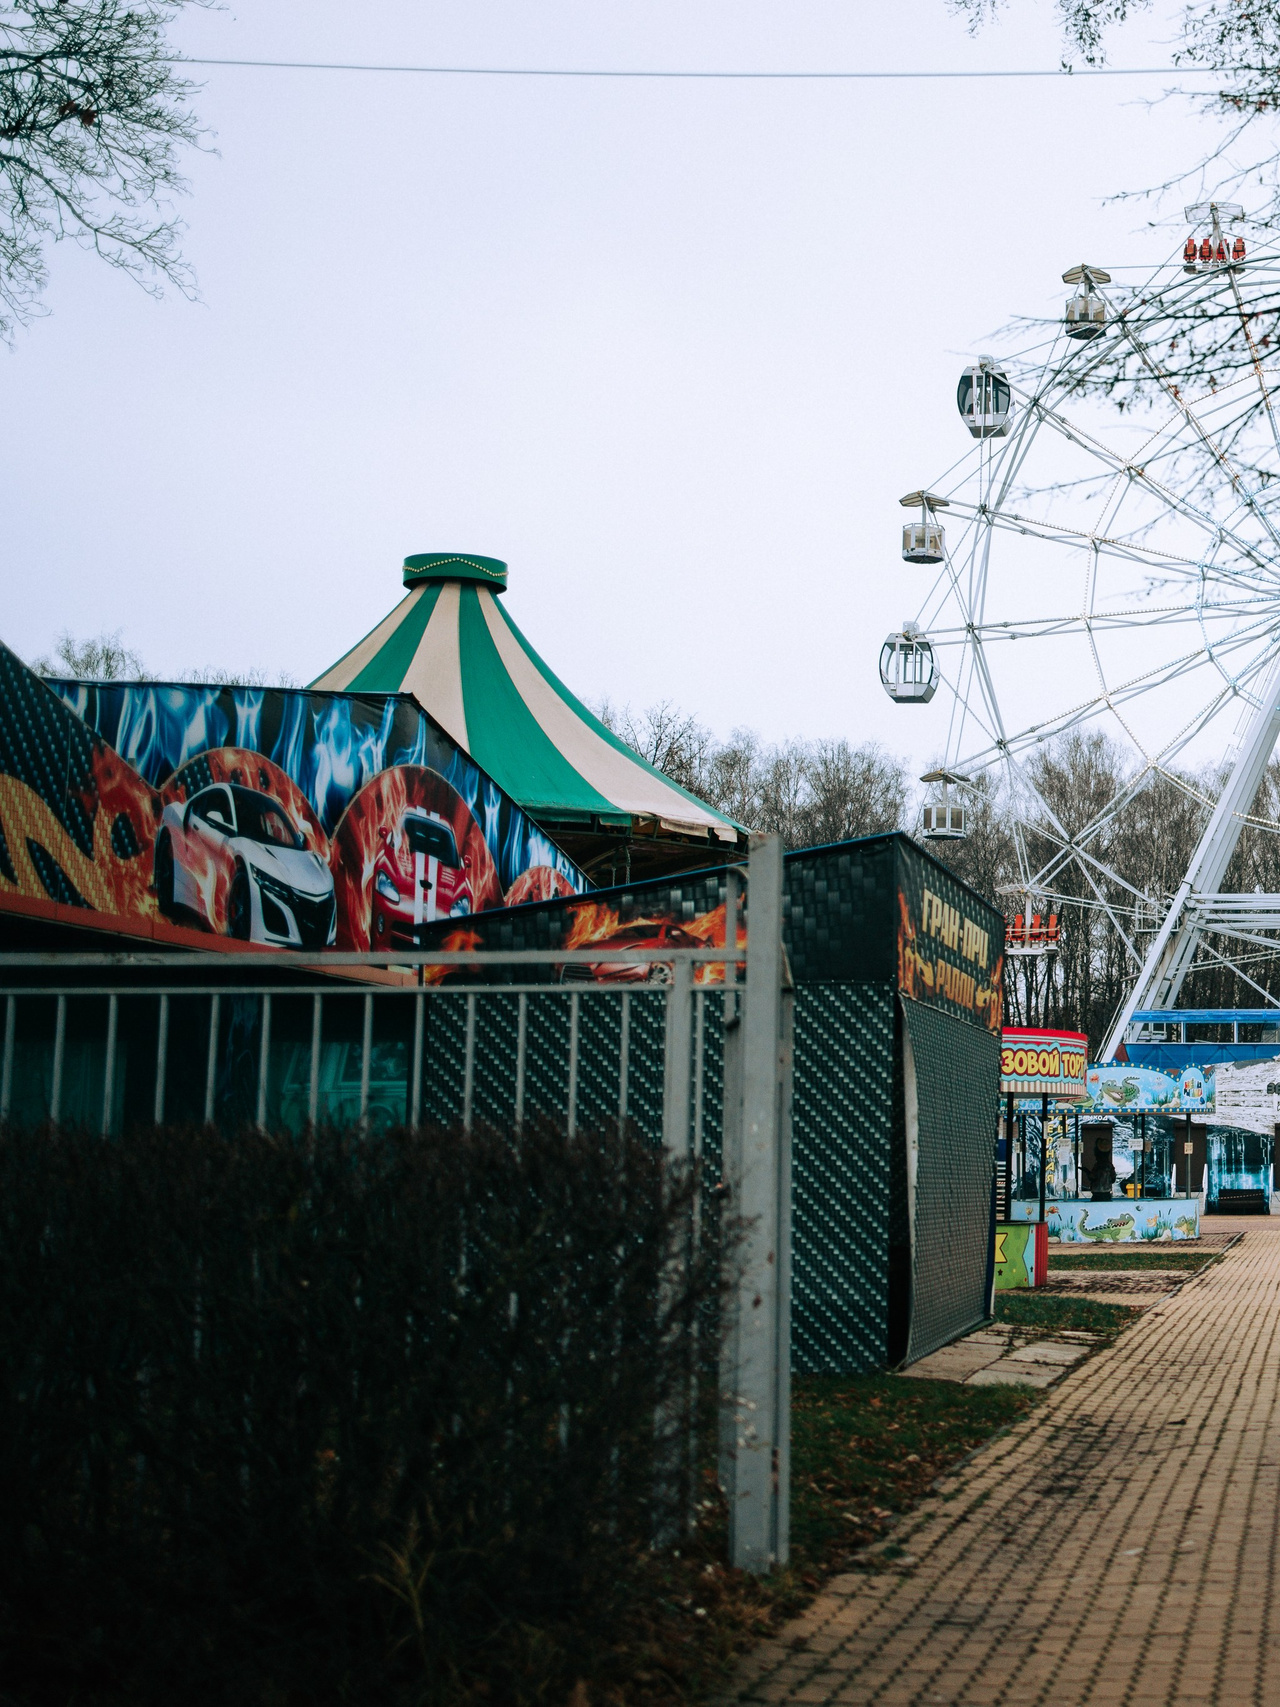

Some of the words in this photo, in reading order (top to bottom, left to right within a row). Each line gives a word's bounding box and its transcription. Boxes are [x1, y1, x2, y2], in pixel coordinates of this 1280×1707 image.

[922, 888, 988, 970] ГРАН-ПРИ
[935, 959, 975, 1010] РАЛЛИ
[1001, 1047, 1060, 1077] ЗОВОЙ
